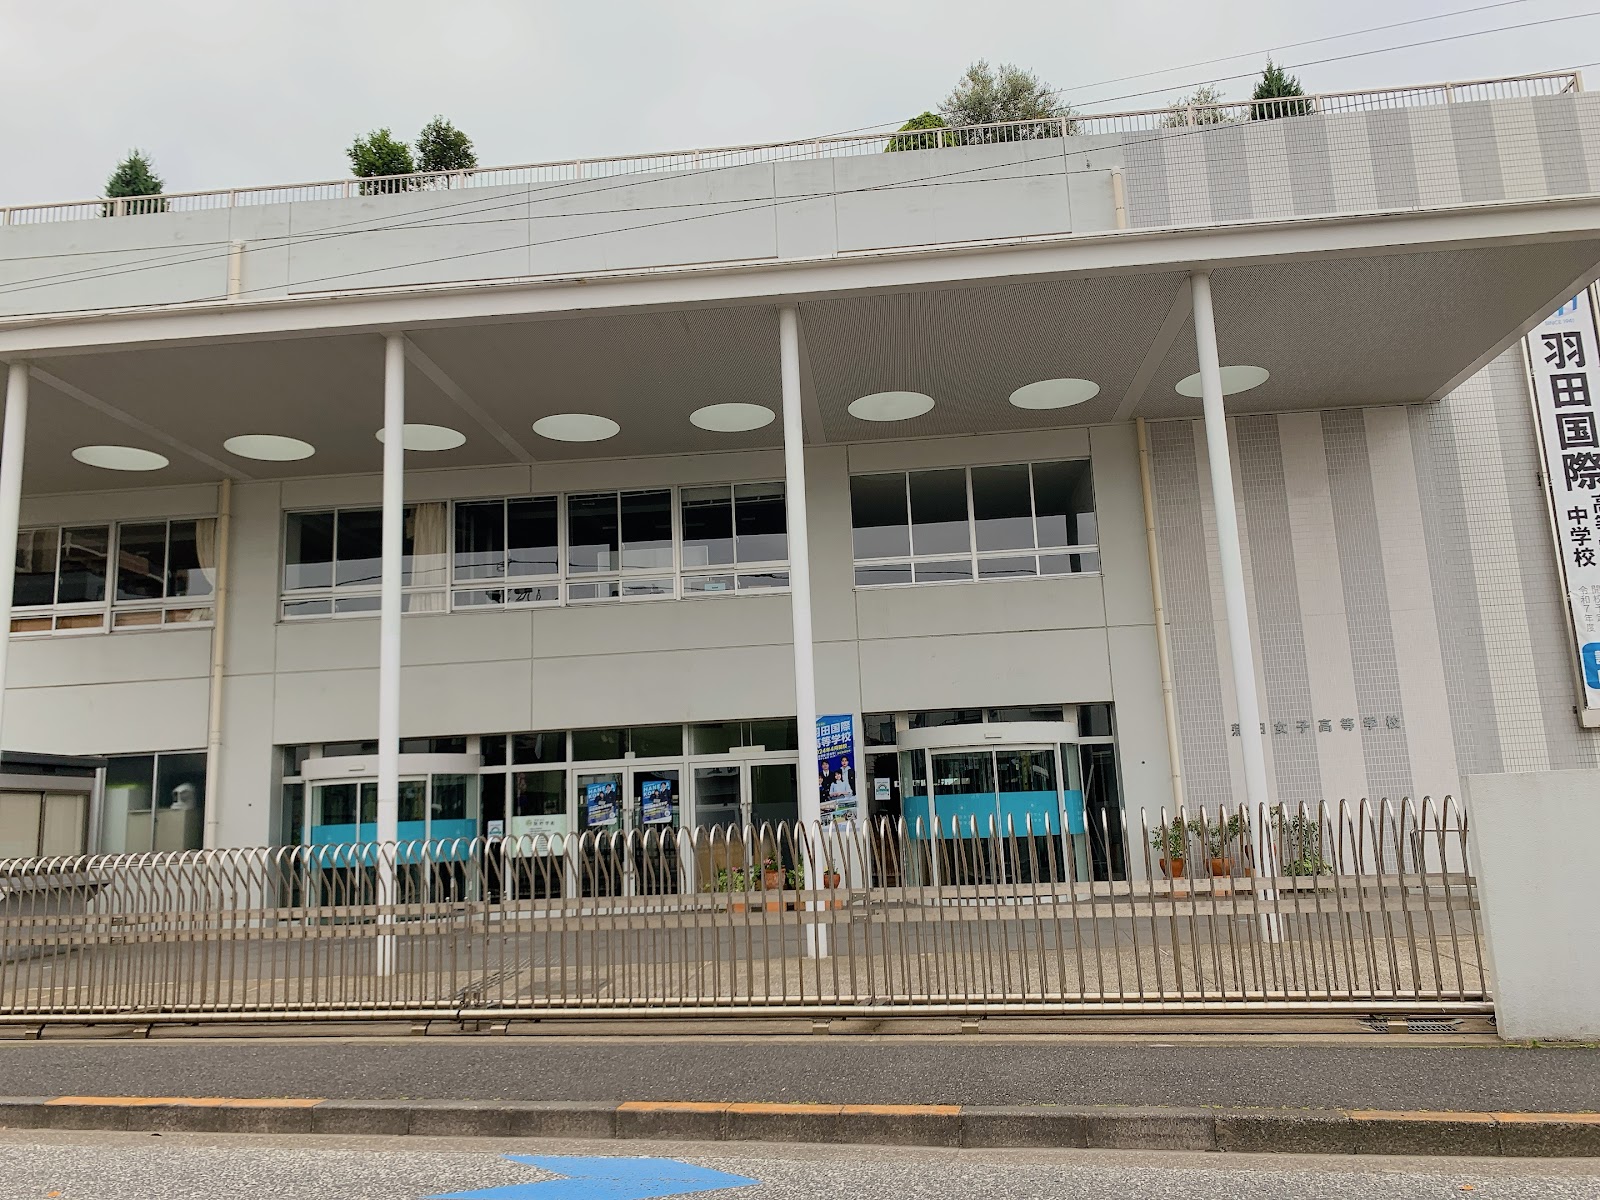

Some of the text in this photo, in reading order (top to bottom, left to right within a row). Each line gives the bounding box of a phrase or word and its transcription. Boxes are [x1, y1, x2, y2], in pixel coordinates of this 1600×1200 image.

[1541, 331, 1600, 491] 羽田国際
[1567, 505, 1596, 567] 中学校
[1578, 585, 1596, 633] 令和7年度
[588, 783, 615, 794] HANEA
[644, 781, 670, 792] HANEA
